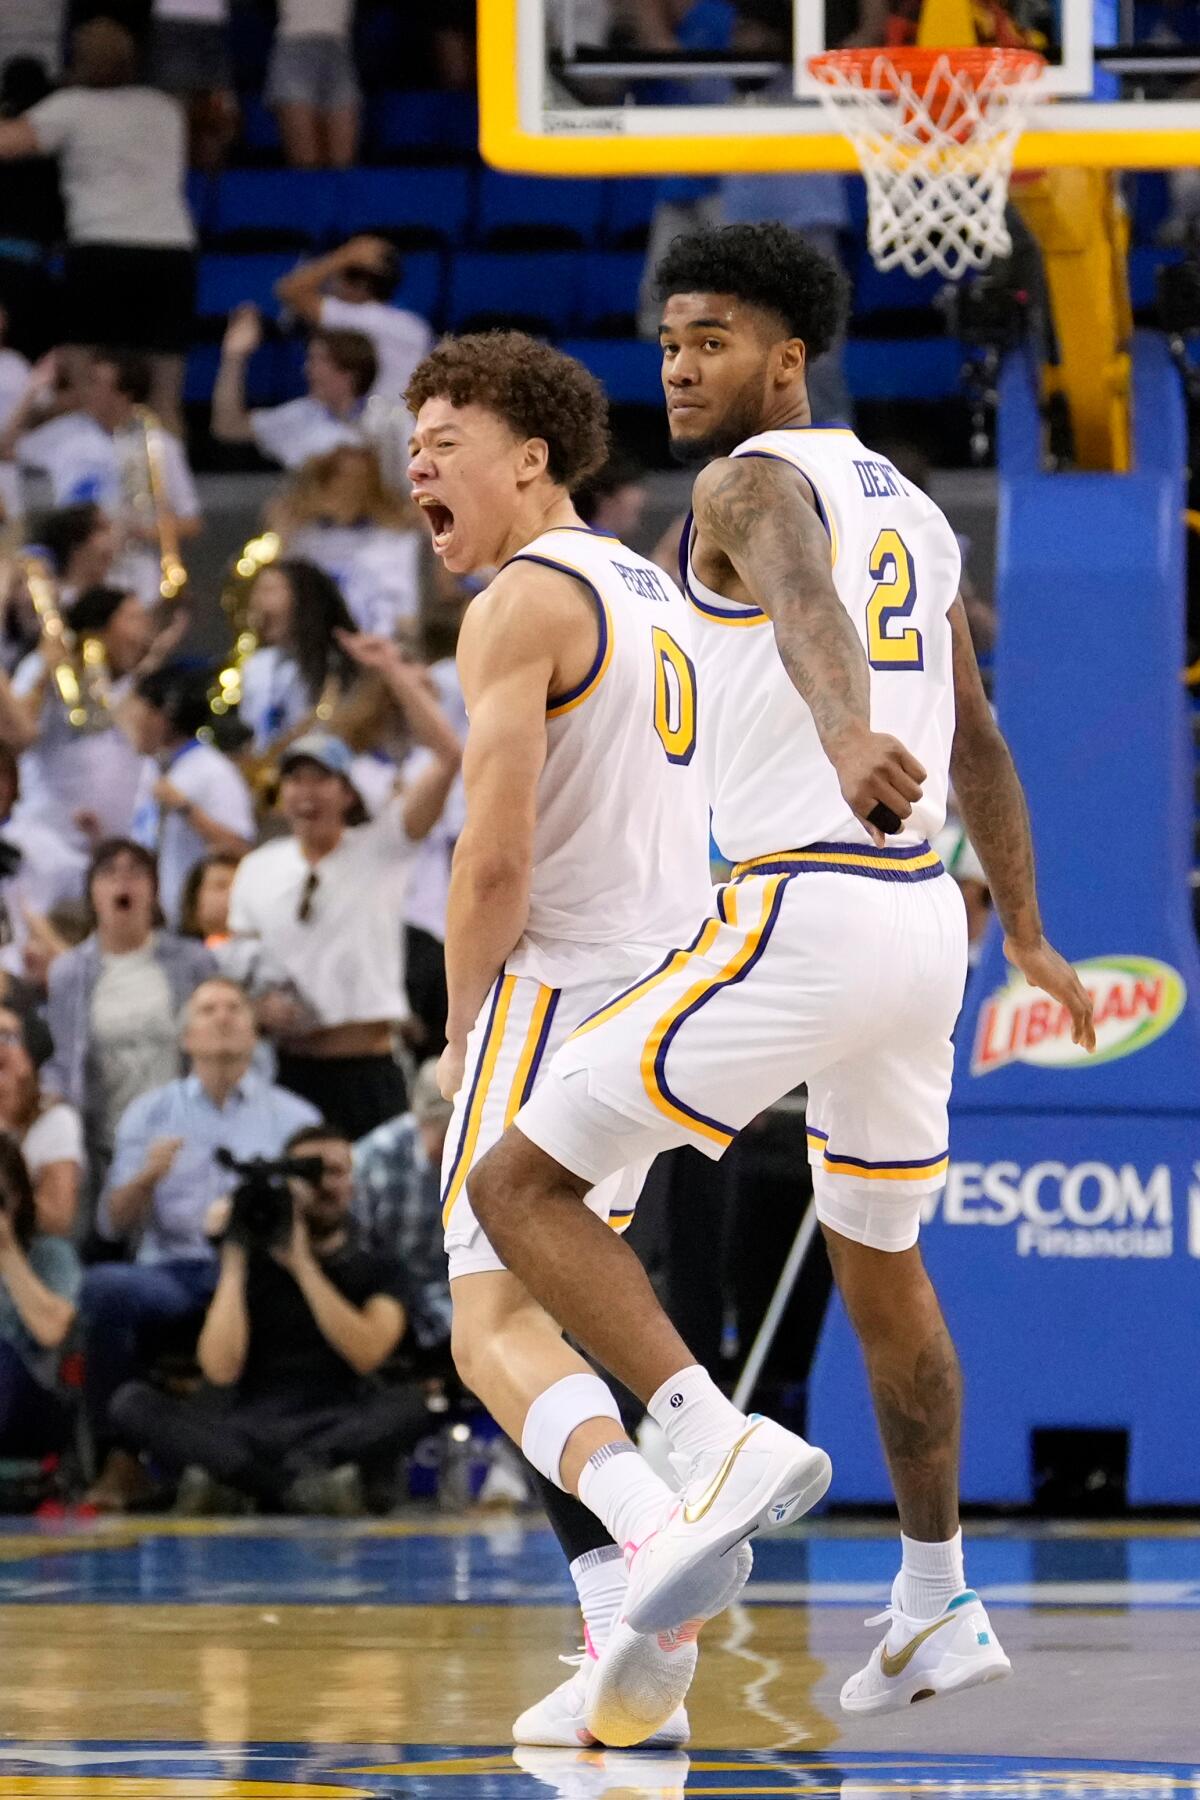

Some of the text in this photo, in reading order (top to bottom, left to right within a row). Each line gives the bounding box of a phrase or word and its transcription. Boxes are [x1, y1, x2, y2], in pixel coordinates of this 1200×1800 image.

[852, 460, 911, 498] DENT
[609, 560, 670, 602] PERRY
[866, 528, 924, 672] 2
[651, 625, 698, 766] 0
[1015, 1222, 1174, 1258] Financial
